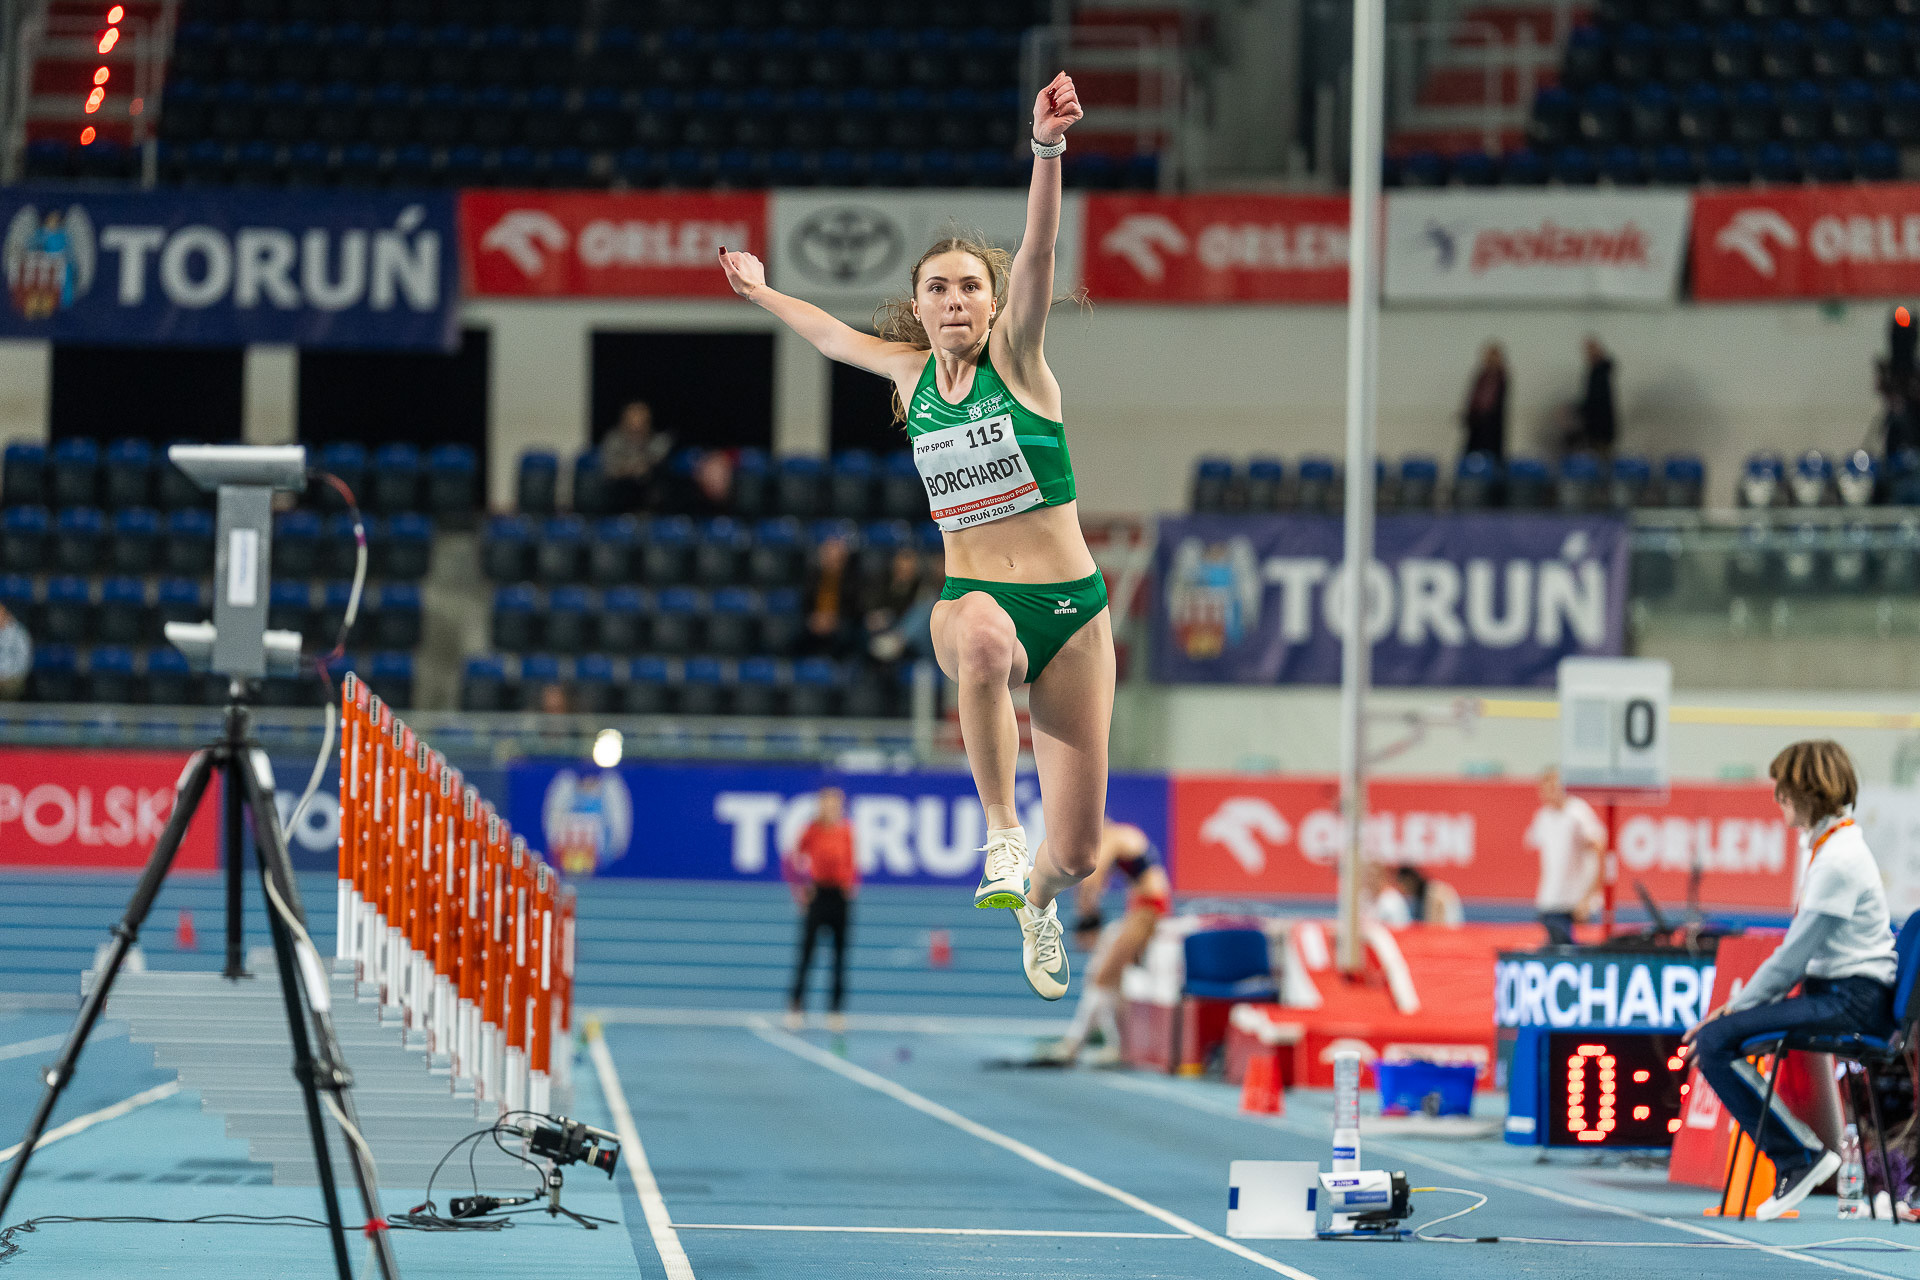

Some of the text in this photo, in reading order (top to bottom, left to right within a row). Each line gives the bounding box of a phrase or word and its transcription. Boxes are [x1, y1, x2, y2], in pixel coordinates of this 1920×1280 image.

[102, 204, 441, 312] TORUŃ
[917, 439, 955, 455] TVP SPORT
[966, 422, 1004, 449] 115
[926, 453, 1023, 497] BORCHARDT
[957, 503, 980, 513] Halowe
[979, 492, 1015, 507] Mistrzostwa
[1015, 484, 1034, 496] Polski
[957, 503, 1016, 526] TORUŃ 2025
[1264, 531, 1606, 647] TORUŃ
[1054, 607, 1078, 615] erima
[1624, 697, 1657, 752] 0
[1618, 814, 1787, 875] ORLEN
